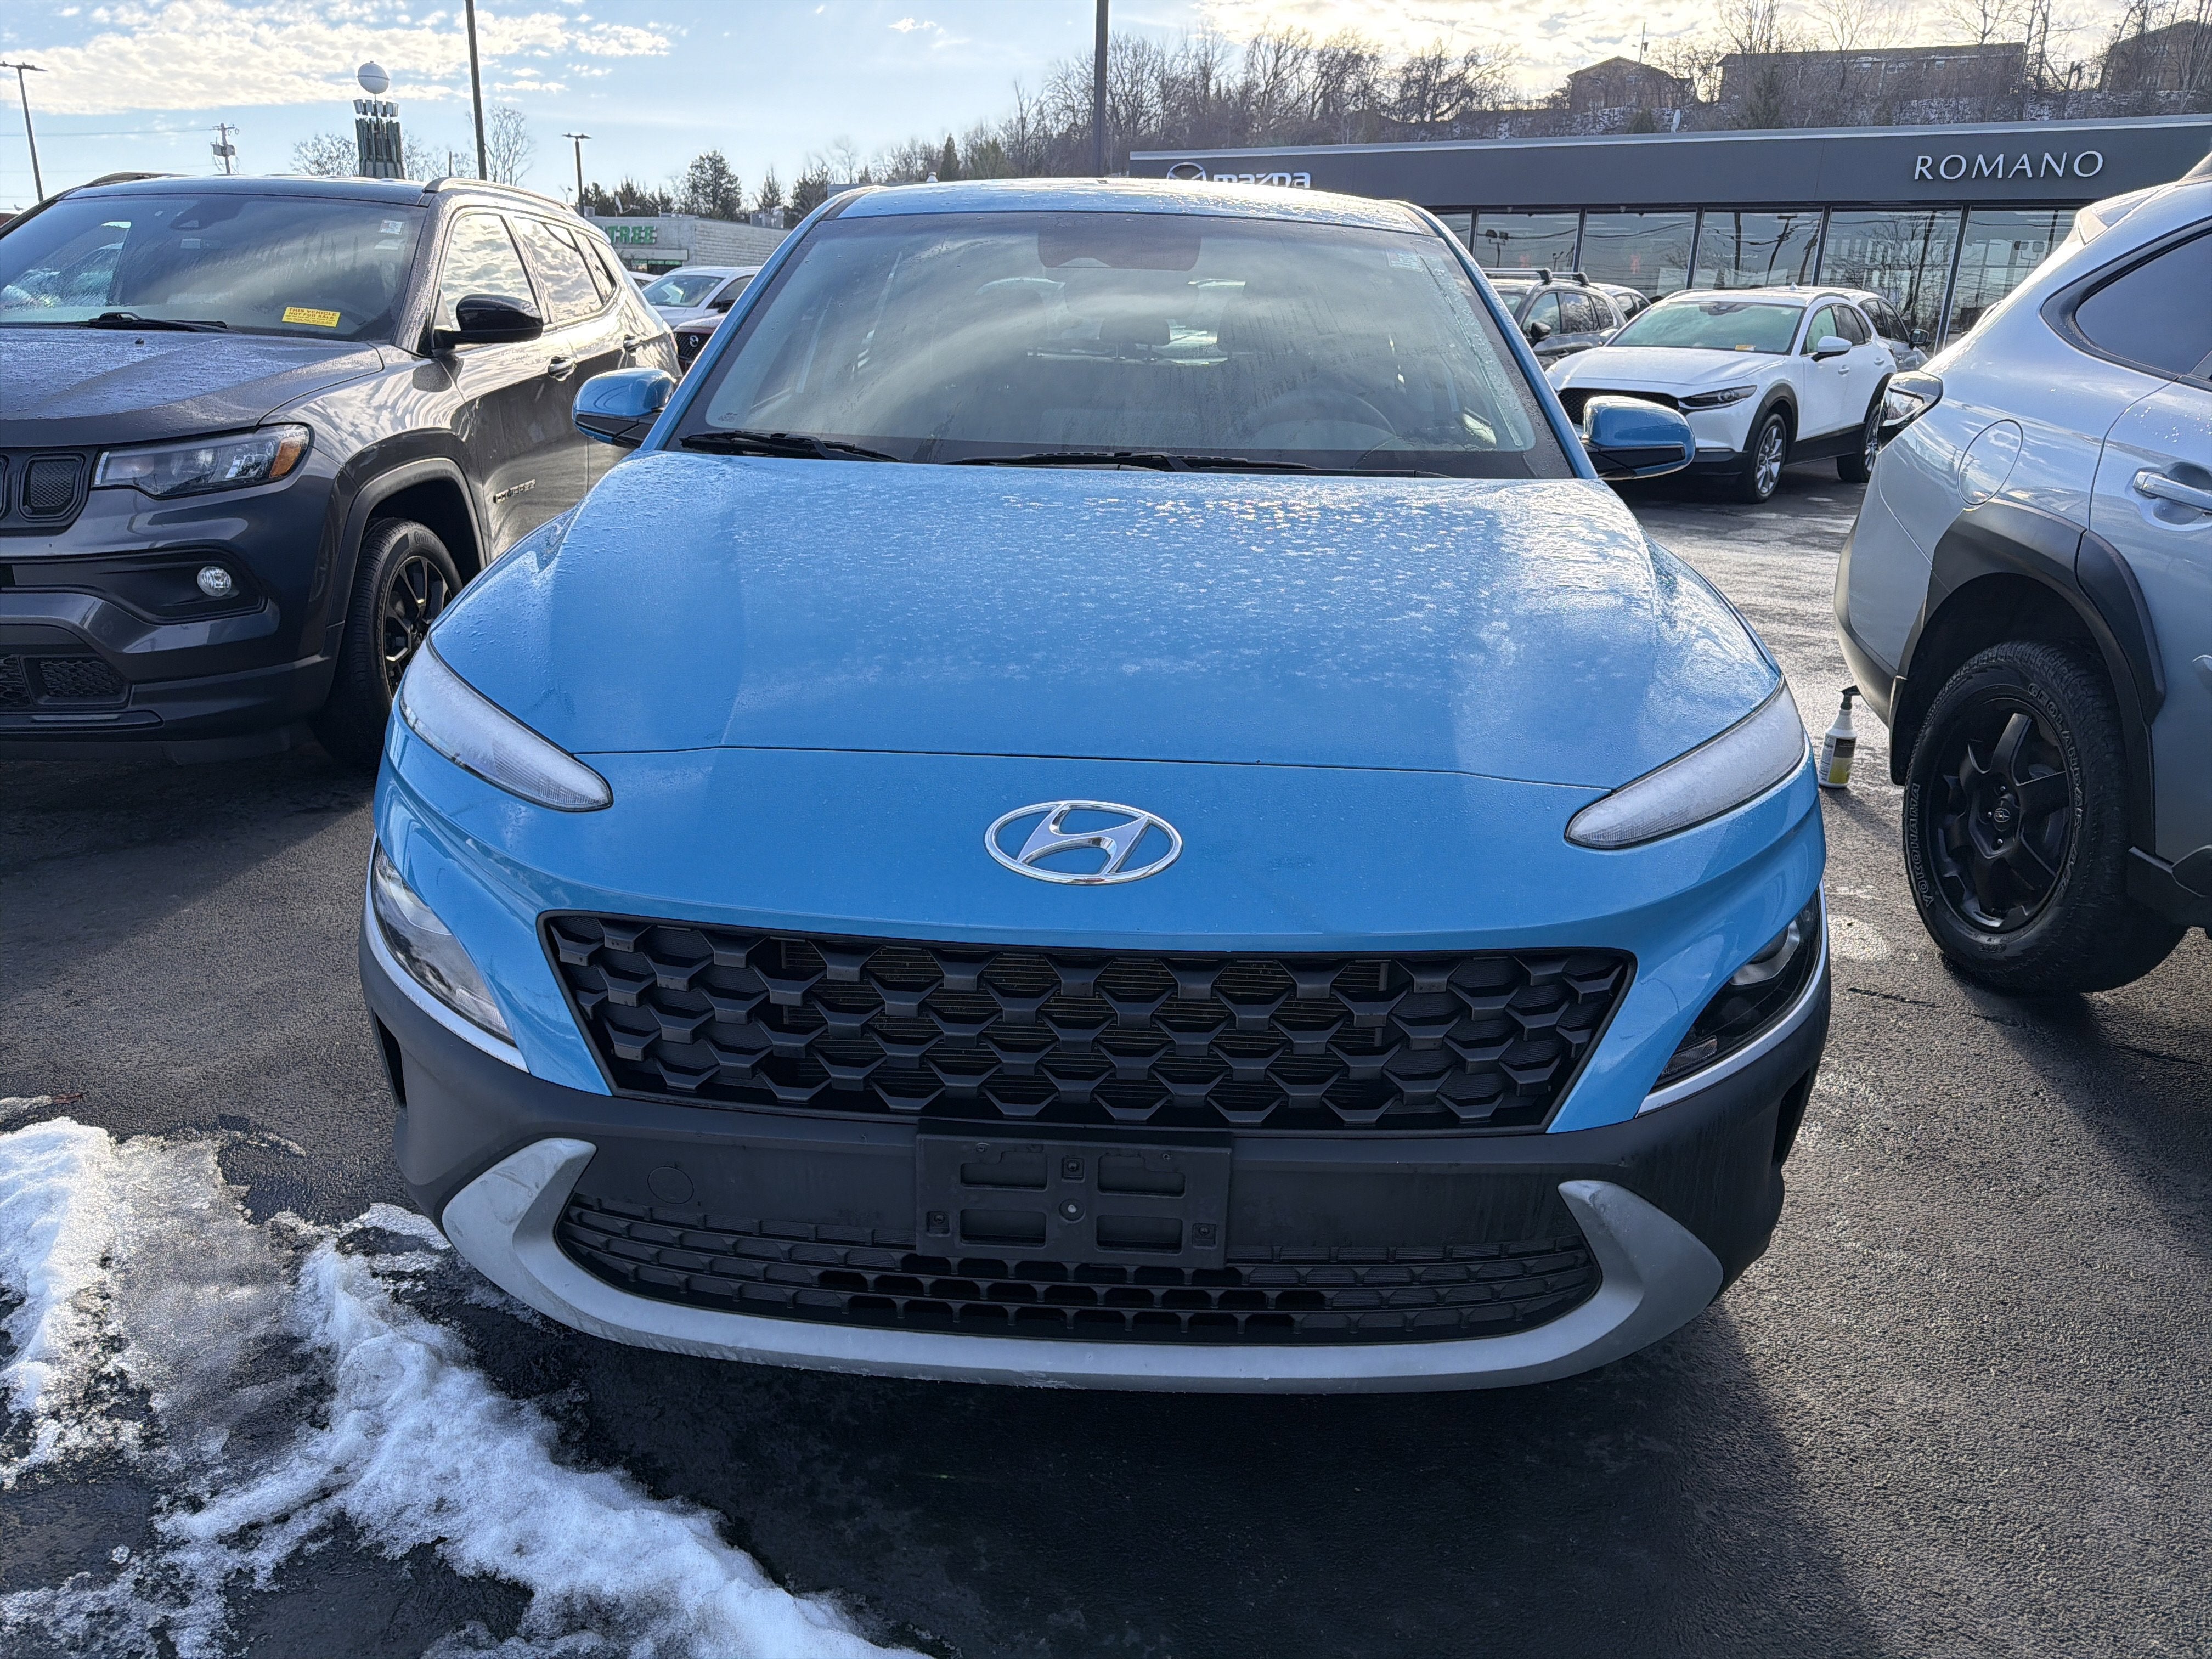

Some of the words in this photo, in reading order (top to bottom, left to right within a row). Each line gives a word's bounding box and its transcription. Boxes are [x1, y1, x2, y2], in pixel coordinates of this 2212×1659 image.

[1914, 150, 2103, 180] ROMANO
[607, 225, 656, 244] TREE
[1910, 783, 1934, 907] YOKOHAMA
